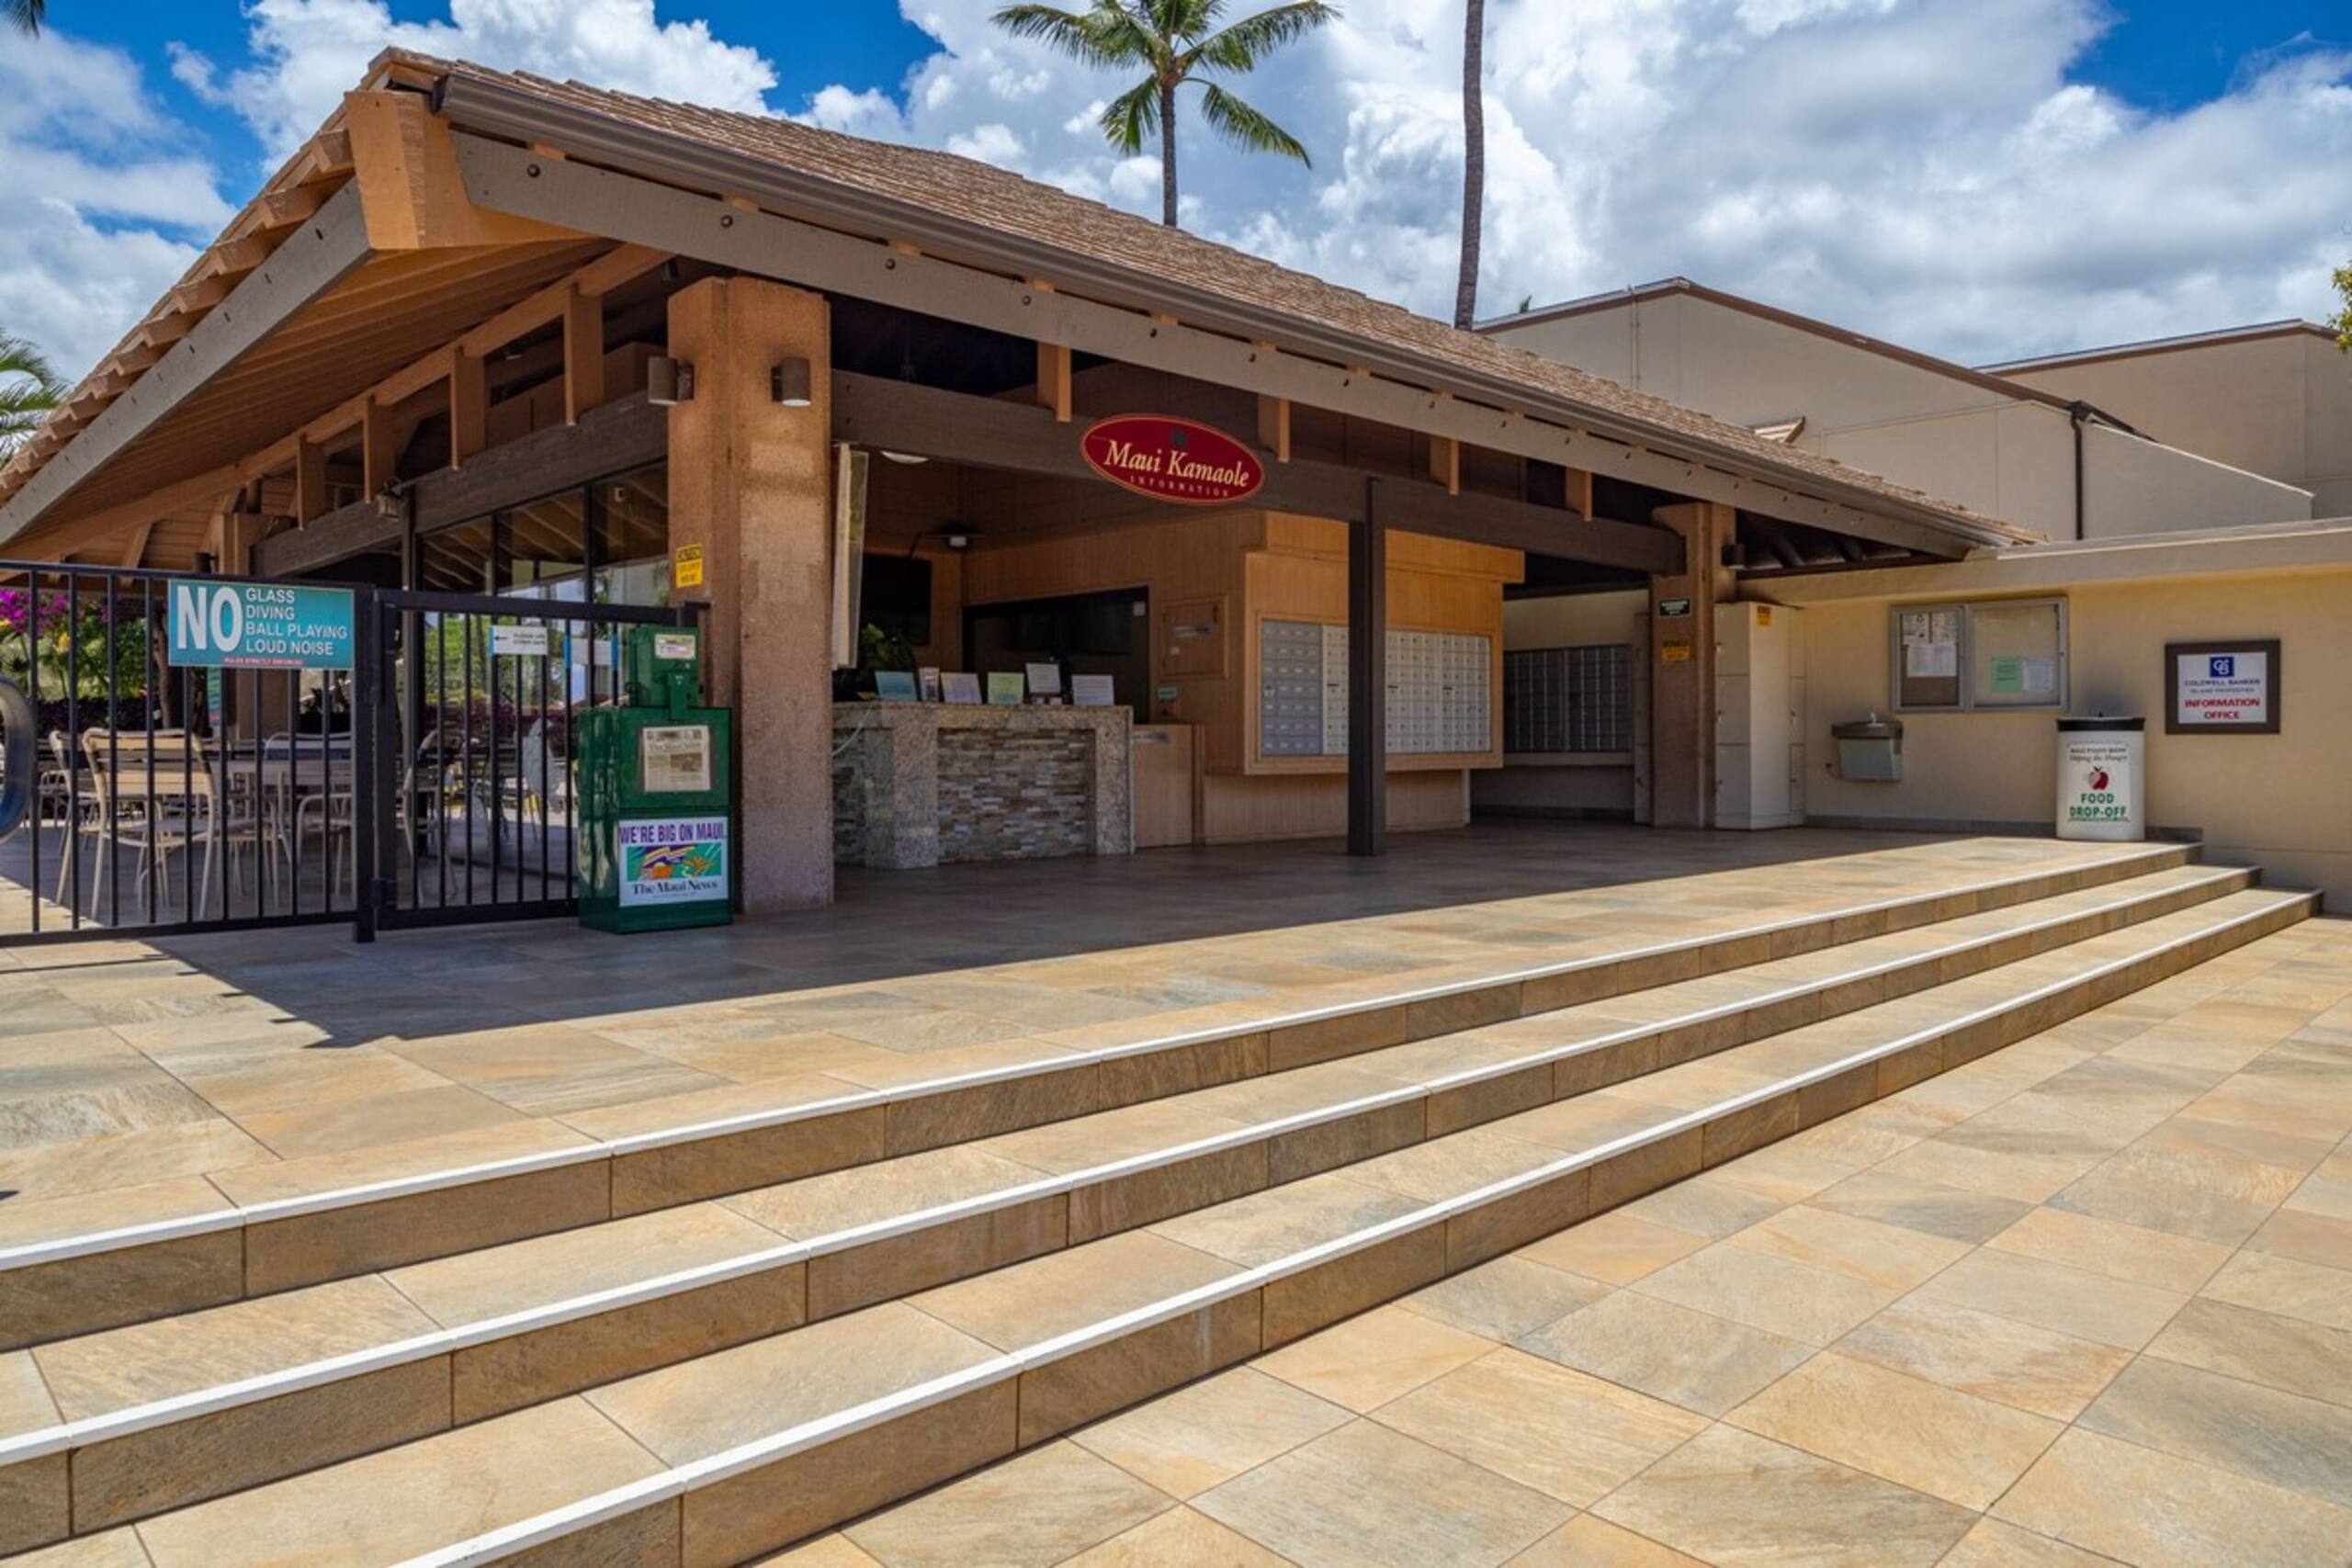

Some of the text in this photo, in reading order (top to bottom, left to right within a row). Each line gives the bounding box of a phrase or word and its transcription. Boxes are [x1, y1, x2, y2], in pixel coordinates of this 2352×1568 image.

[1103, 439, 1250, 488] Maui Kamaole
[1130, 475, 1228, 497] INFORMATION
[245, 587, 295, 604] GLASS
[176, 585, 243, 652] NO
[245, 605, 295, 620] DIVING
[245, 621, 347, 639] BALL PLAYING
[245, 639, 334, 656] LOUD NOISE
[2185, 699, 2259, 707] INFORMATION
[2204, 711, 2240, 719] OFFICE
[2081, 793, 2114, 804] FOOD
[2069, 806, 2127, 817] DROP-OFF
[618, 825, 654, 843] WE'RE
[658, 824, 676, 842] BIG
[680, 823, 694, 841] ON
[633, 880, 718, 896] The Maui News
